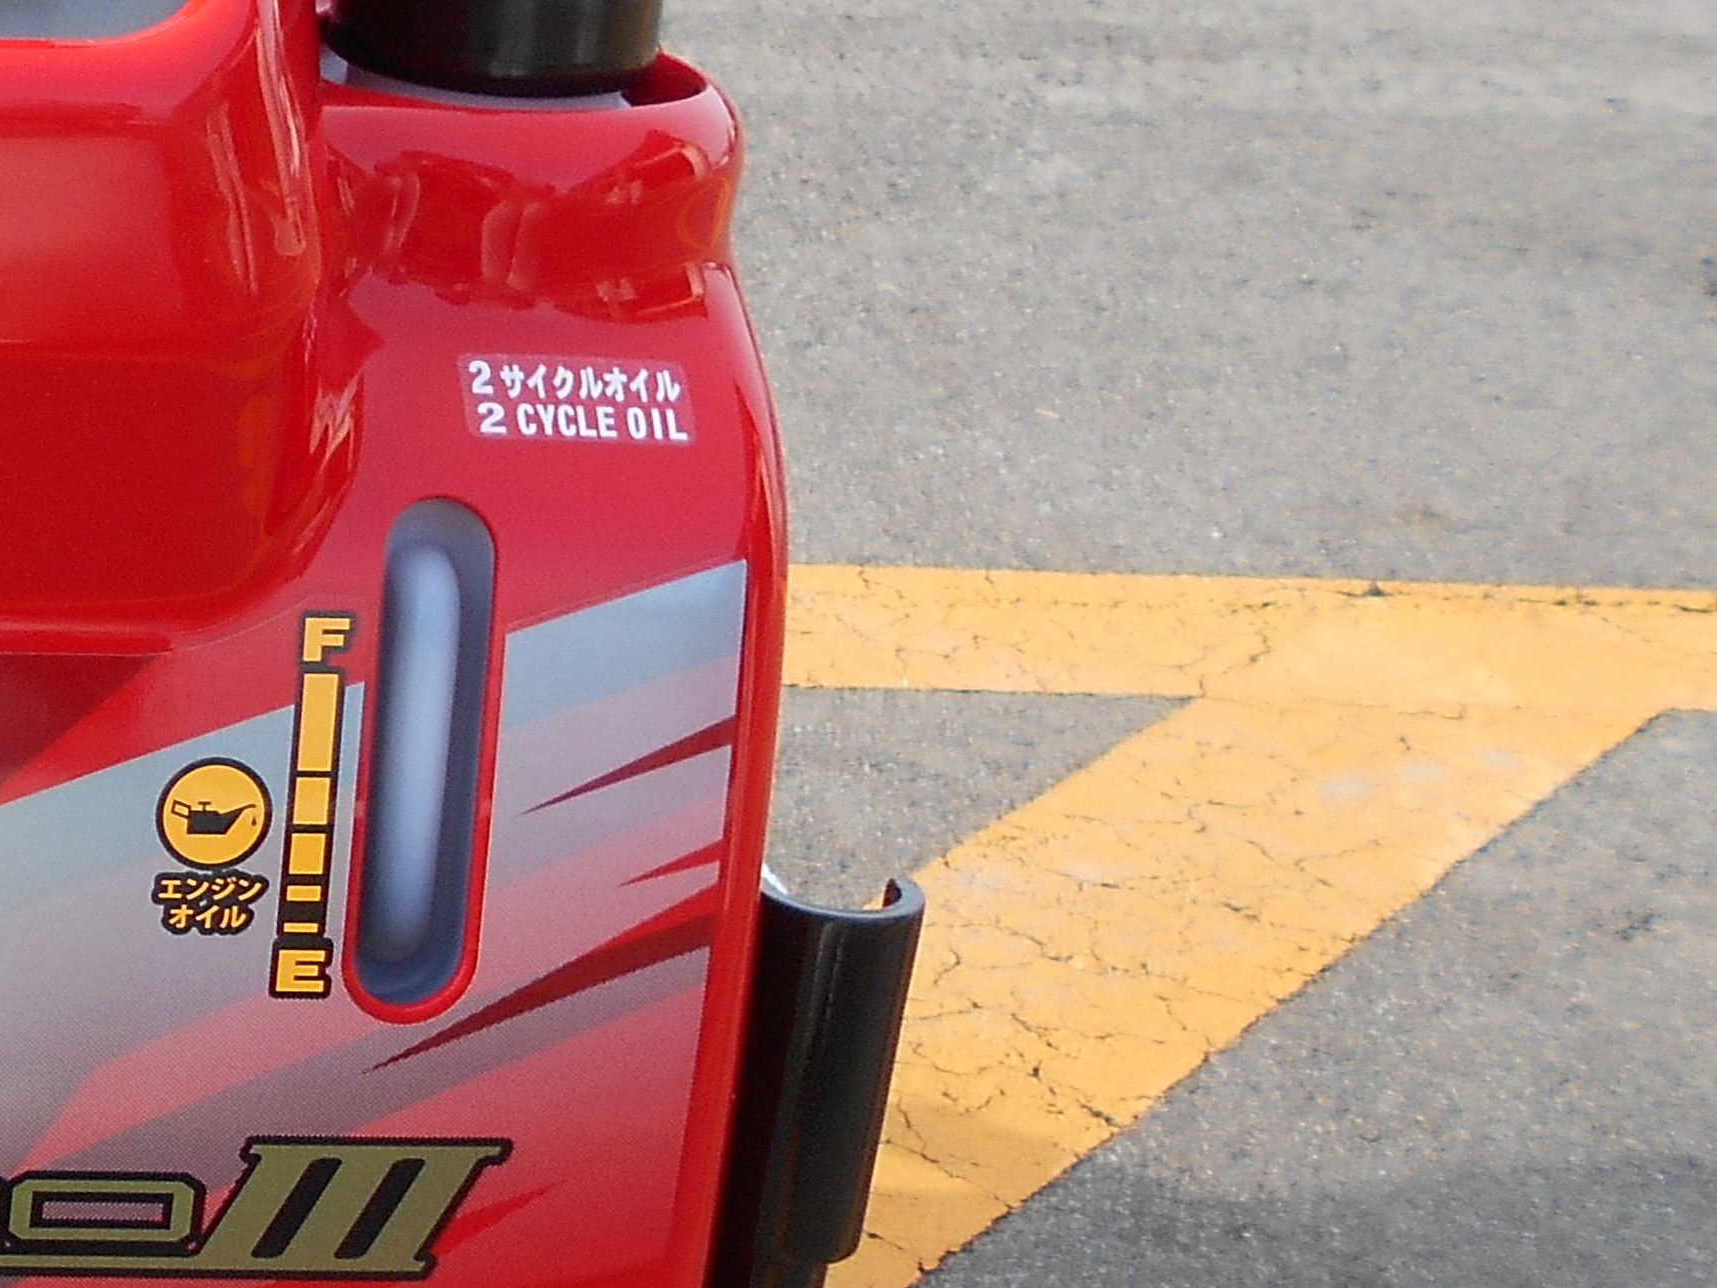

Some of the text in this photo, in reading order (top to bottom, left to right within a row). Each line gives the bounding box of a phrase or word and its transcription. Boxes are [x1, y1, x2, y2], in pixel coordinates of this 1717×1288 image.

[477, 402, 688, 440] 2 CYCLE OIL
[303, 617, 350, 662] F
[158, 876, 262, 901] エンジン
[169, 904, 246, 929] オイル
[275, 950, 325, 993] E
